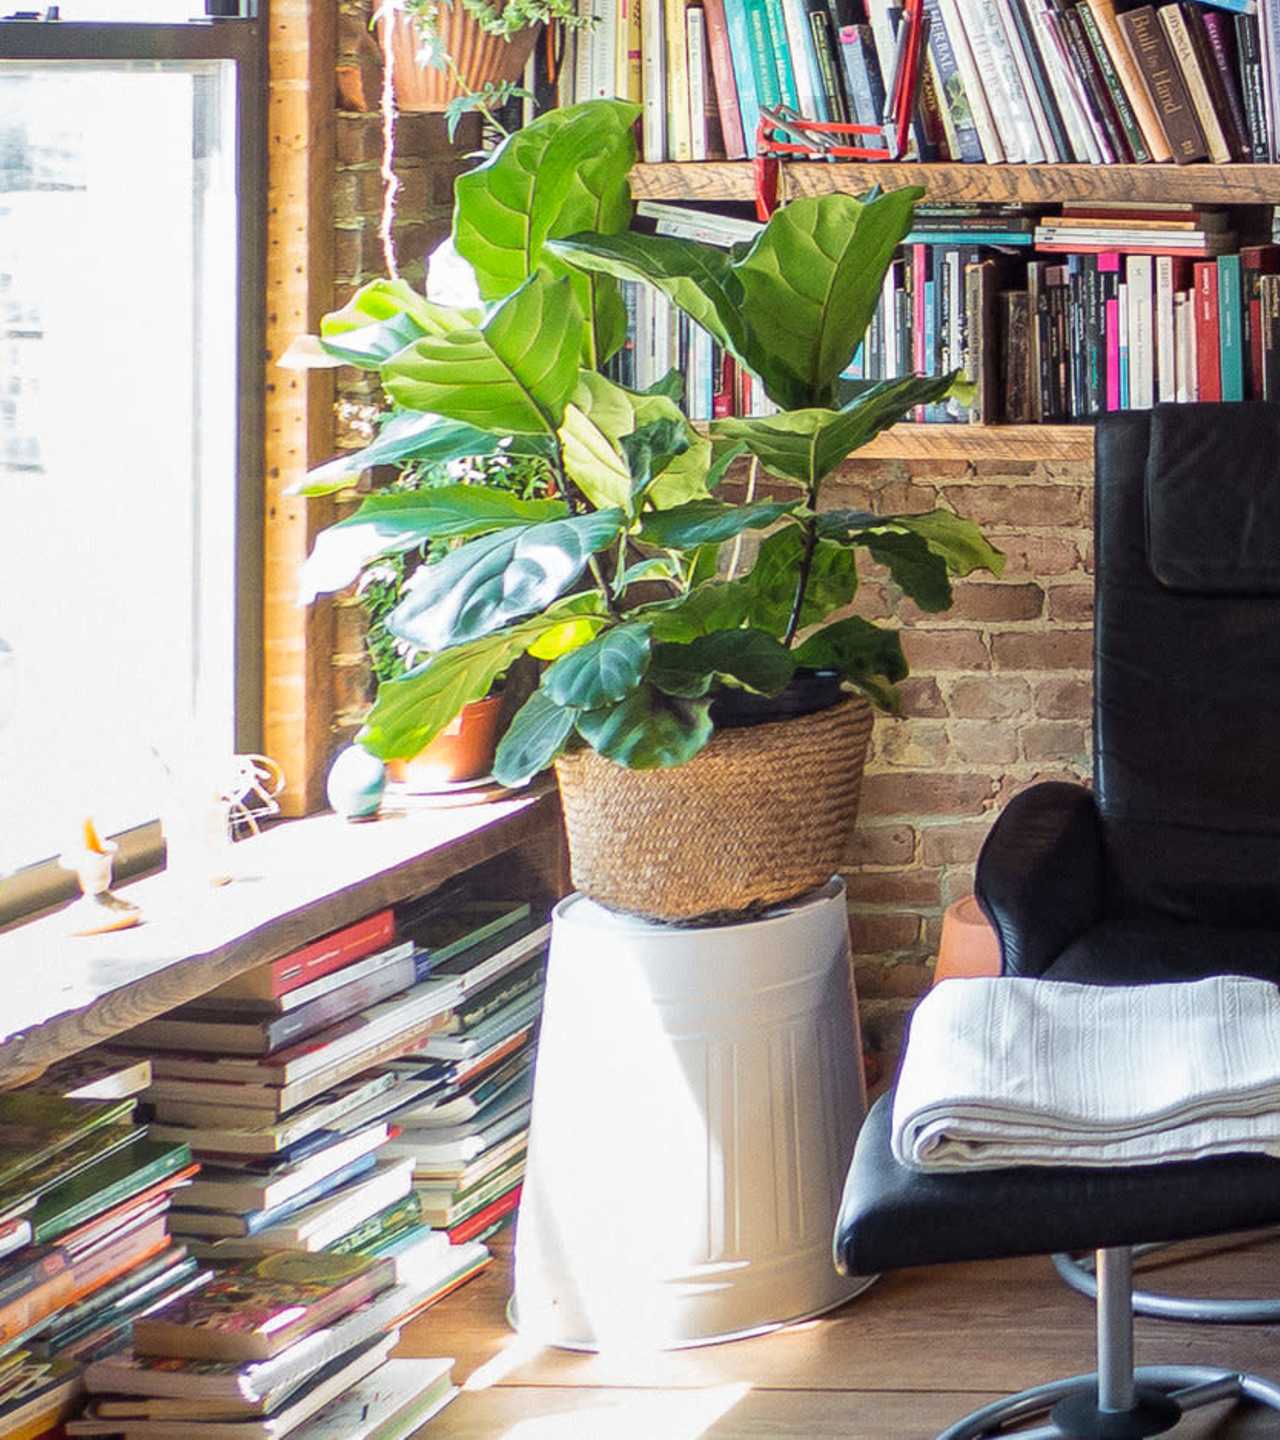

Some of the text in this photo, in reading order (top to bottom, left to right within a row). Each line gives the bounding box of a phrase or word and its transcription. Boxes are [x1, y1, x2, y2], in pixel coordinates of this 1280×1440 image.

[930, 9, 953, 72] HERBAL
[1131, 15, 1155, 53] Built
[1153, 70, 1177, 115] Hand
